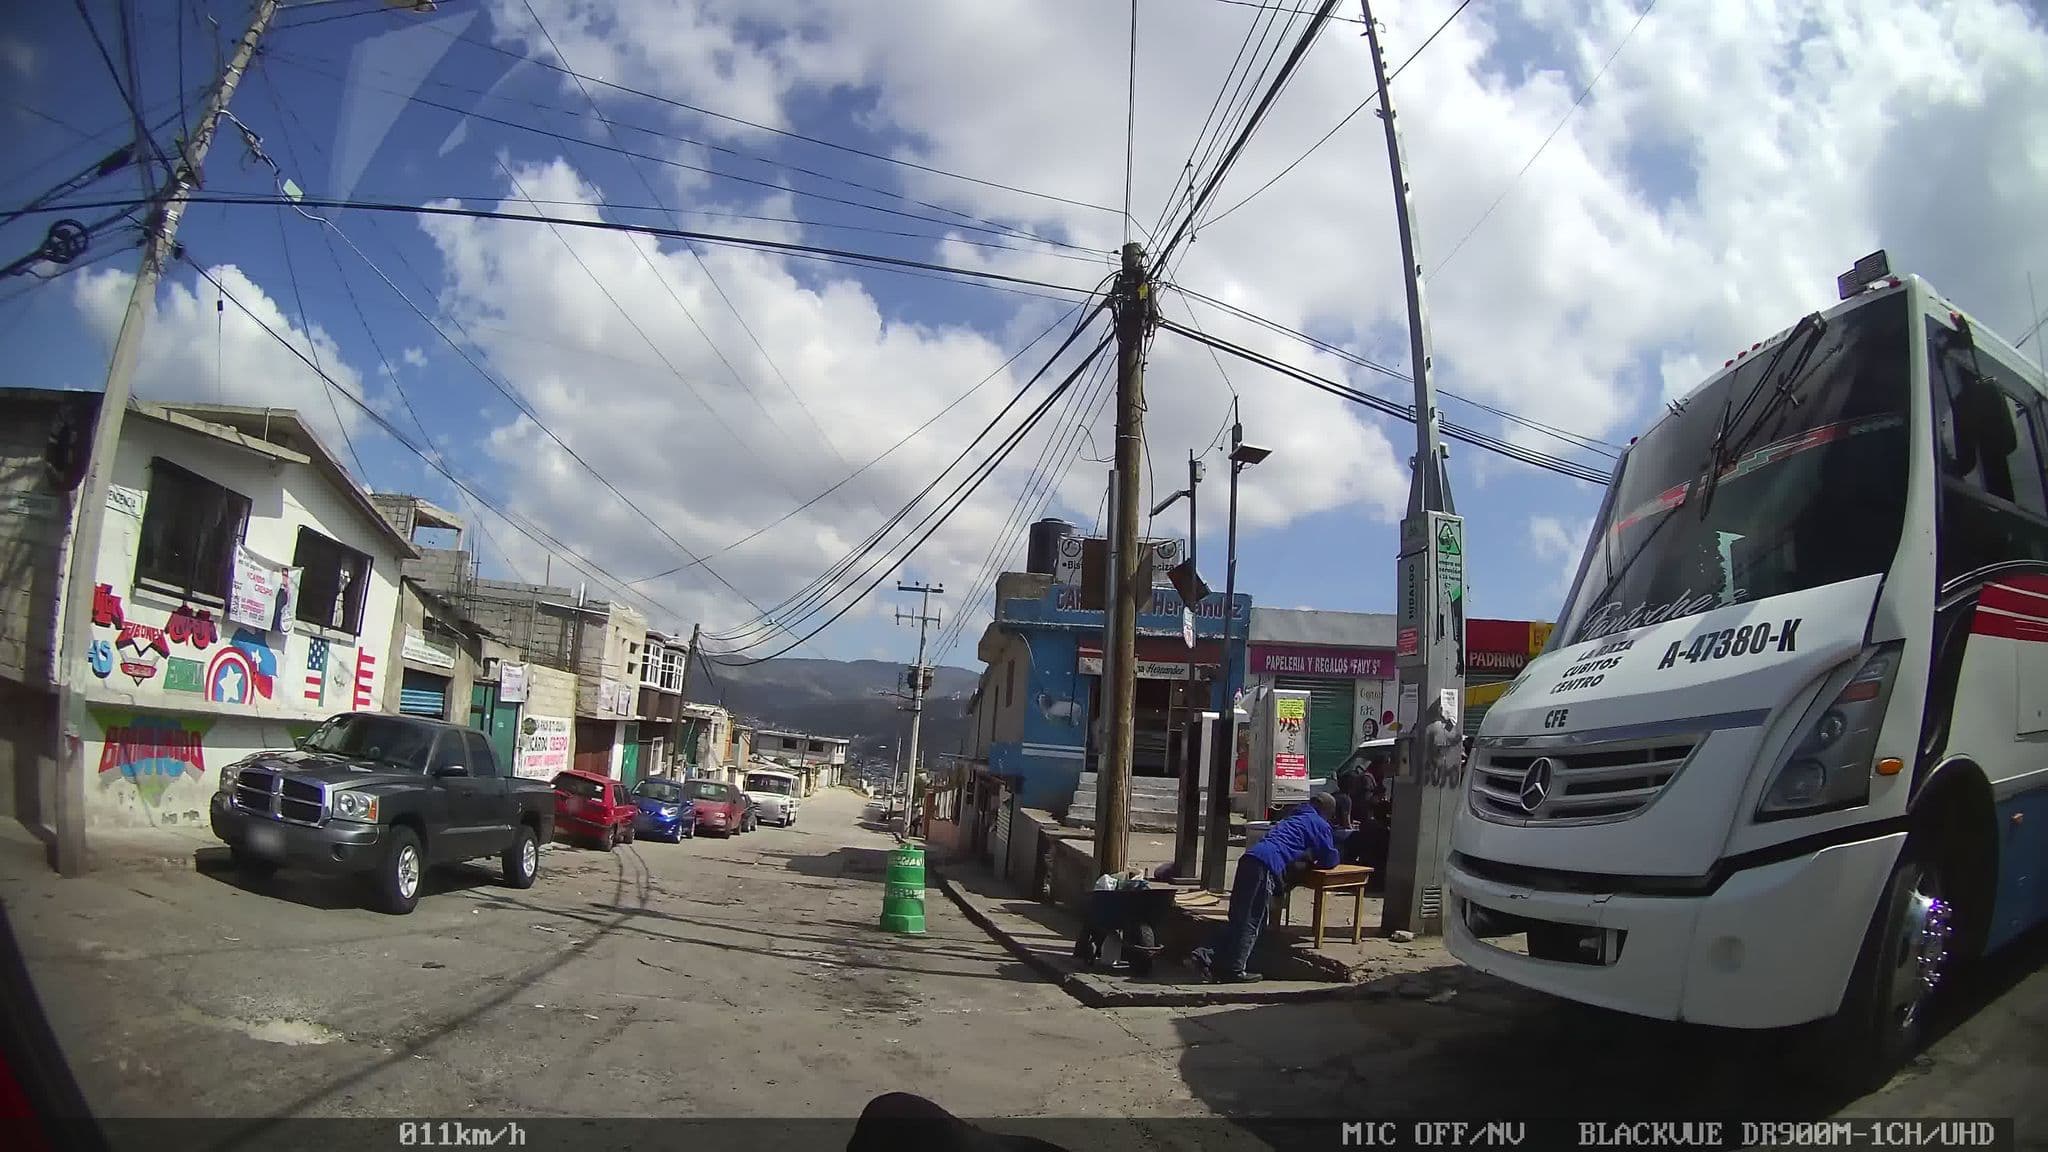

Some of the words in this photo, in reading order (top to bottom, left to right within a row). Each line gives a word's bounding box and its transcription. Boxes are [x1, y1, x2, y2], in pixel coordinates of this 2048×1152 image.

[1576, 649, 1591, 663] LA
[1595, 639, 1636, 658] RAZA
[1657, 618, 1803, 671] A-47380-K
[1265, 655, 1305, 672] PAPELERIA
[1307, 657, 1313, 672] Y
[1315, 657, 1348, 674] REGALOS
[1469, 652, 1524, 668] PADRINO
[1562, 656, 1623, 679] CUBITOS
[1550, 673, 1605, 695] CENTRO
[1544, 709, 1569, 728] CFE
